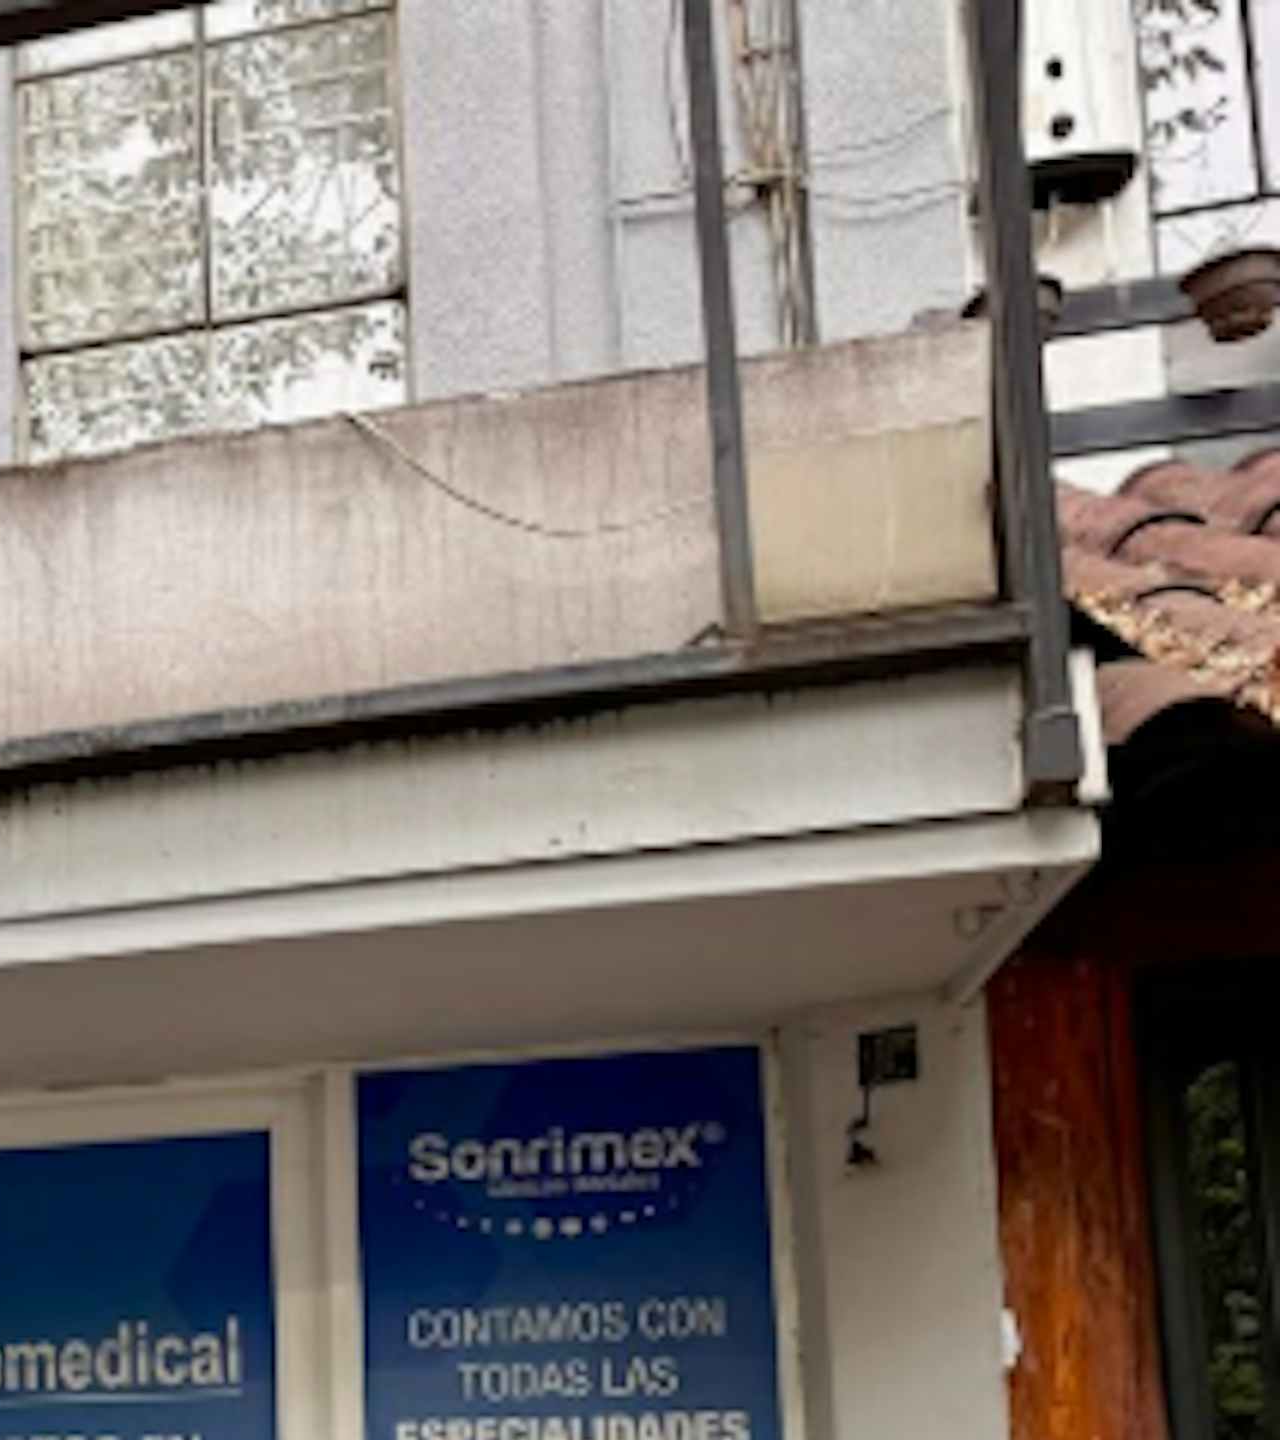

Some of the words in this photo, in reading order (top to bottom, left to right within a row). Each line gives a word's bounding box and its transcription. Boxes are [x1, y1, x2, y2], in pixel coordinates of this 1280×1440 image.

[408, 1303, 628, 1349] CONTAMOS
[639, 1297, 727, 1341] CON
[458, 1361, 592, 1402] TODAS
[601, 1356, 679, 1397] LAS
